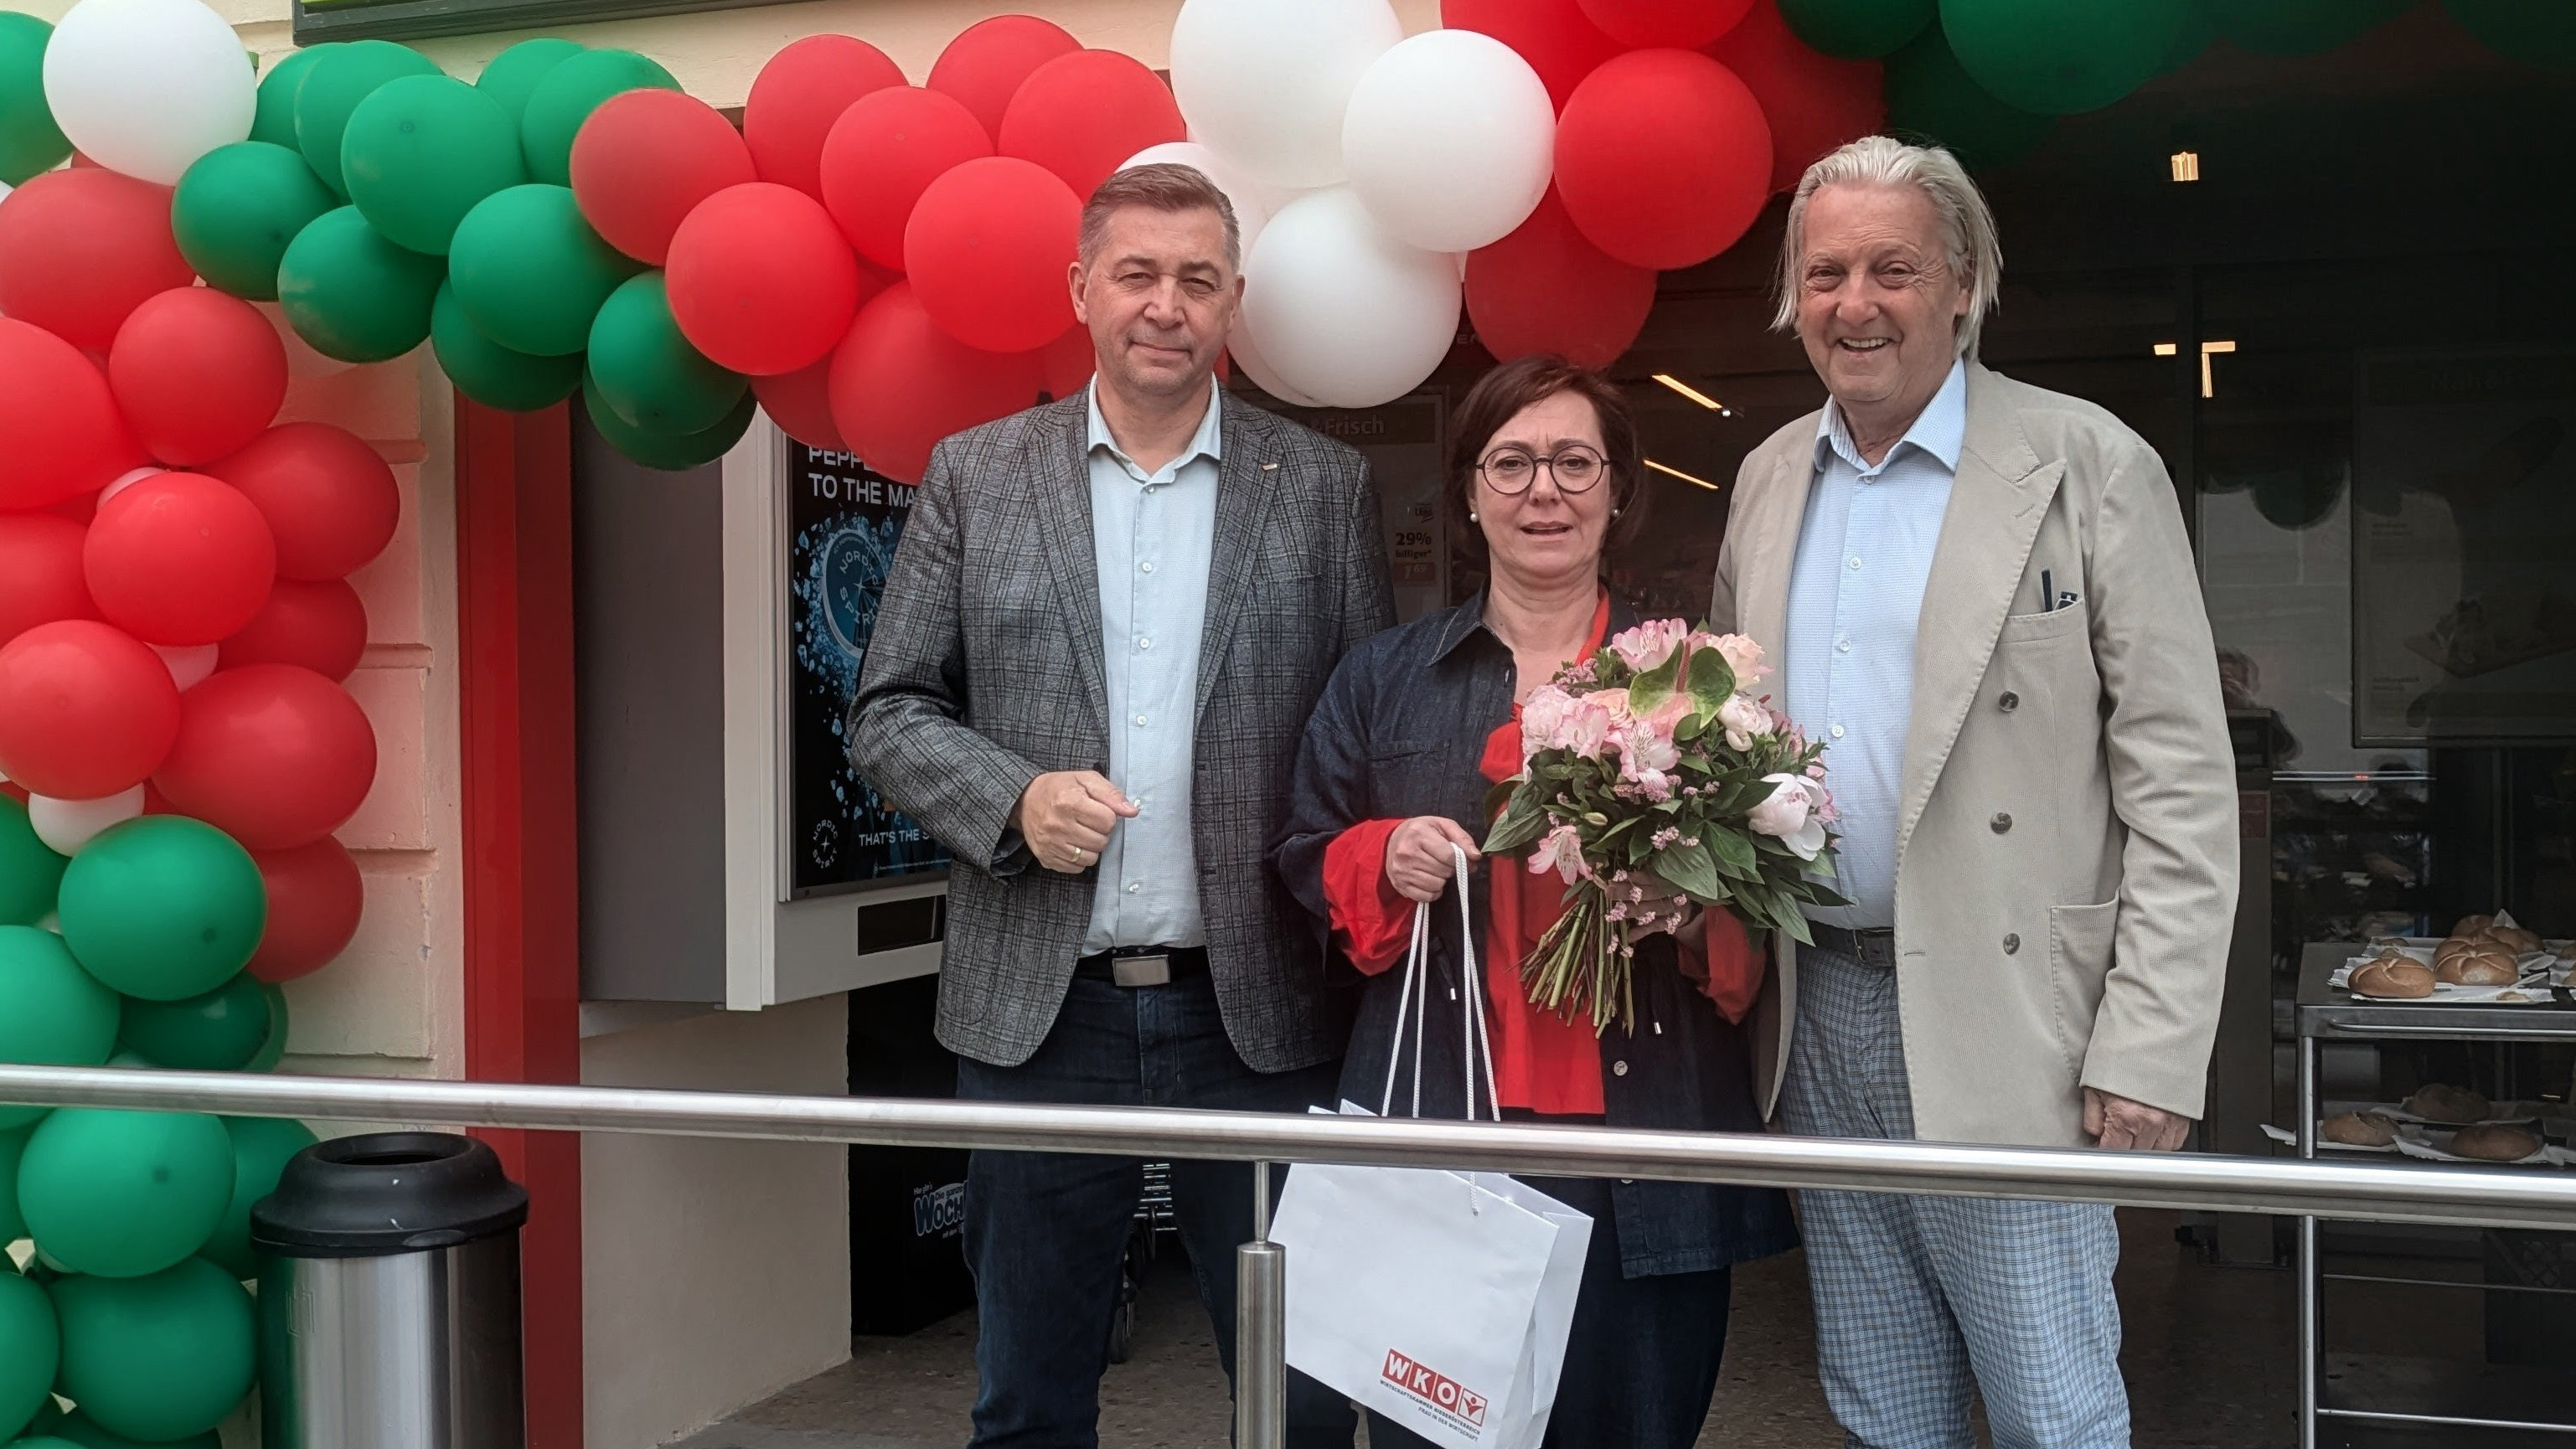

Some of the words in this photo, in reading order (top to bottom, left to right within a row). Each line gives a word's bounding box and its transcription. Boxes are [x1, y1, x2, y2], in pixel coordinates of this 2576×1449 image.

[808, 472, 837, 499] TO
[843, 477, 882, 505] THE
[1396, 532, 1432, 546] 29%
[839, 550, 879, 585] NORDIC
[812, 819, 839, 841] NORDIC
[859, 831, 896, 847] THAT'S
[899, 828, 920, 843] THE
[1388, 1353, 1457, 1405] WKO
[1380, 1379, 1433, 1410] WIRTSCHAFTSKAMMER
[1433, 1407, 1481, 1436] NIEDERÖSTERREICH
[1417, 1406, 1432, 1418] FRAU
[1432, 1413, 1438, 1421] IN
[1438, 1416, 1448, 1426] DER
[1448, 1422, 1479, 1442] WIRTSCHAFT
